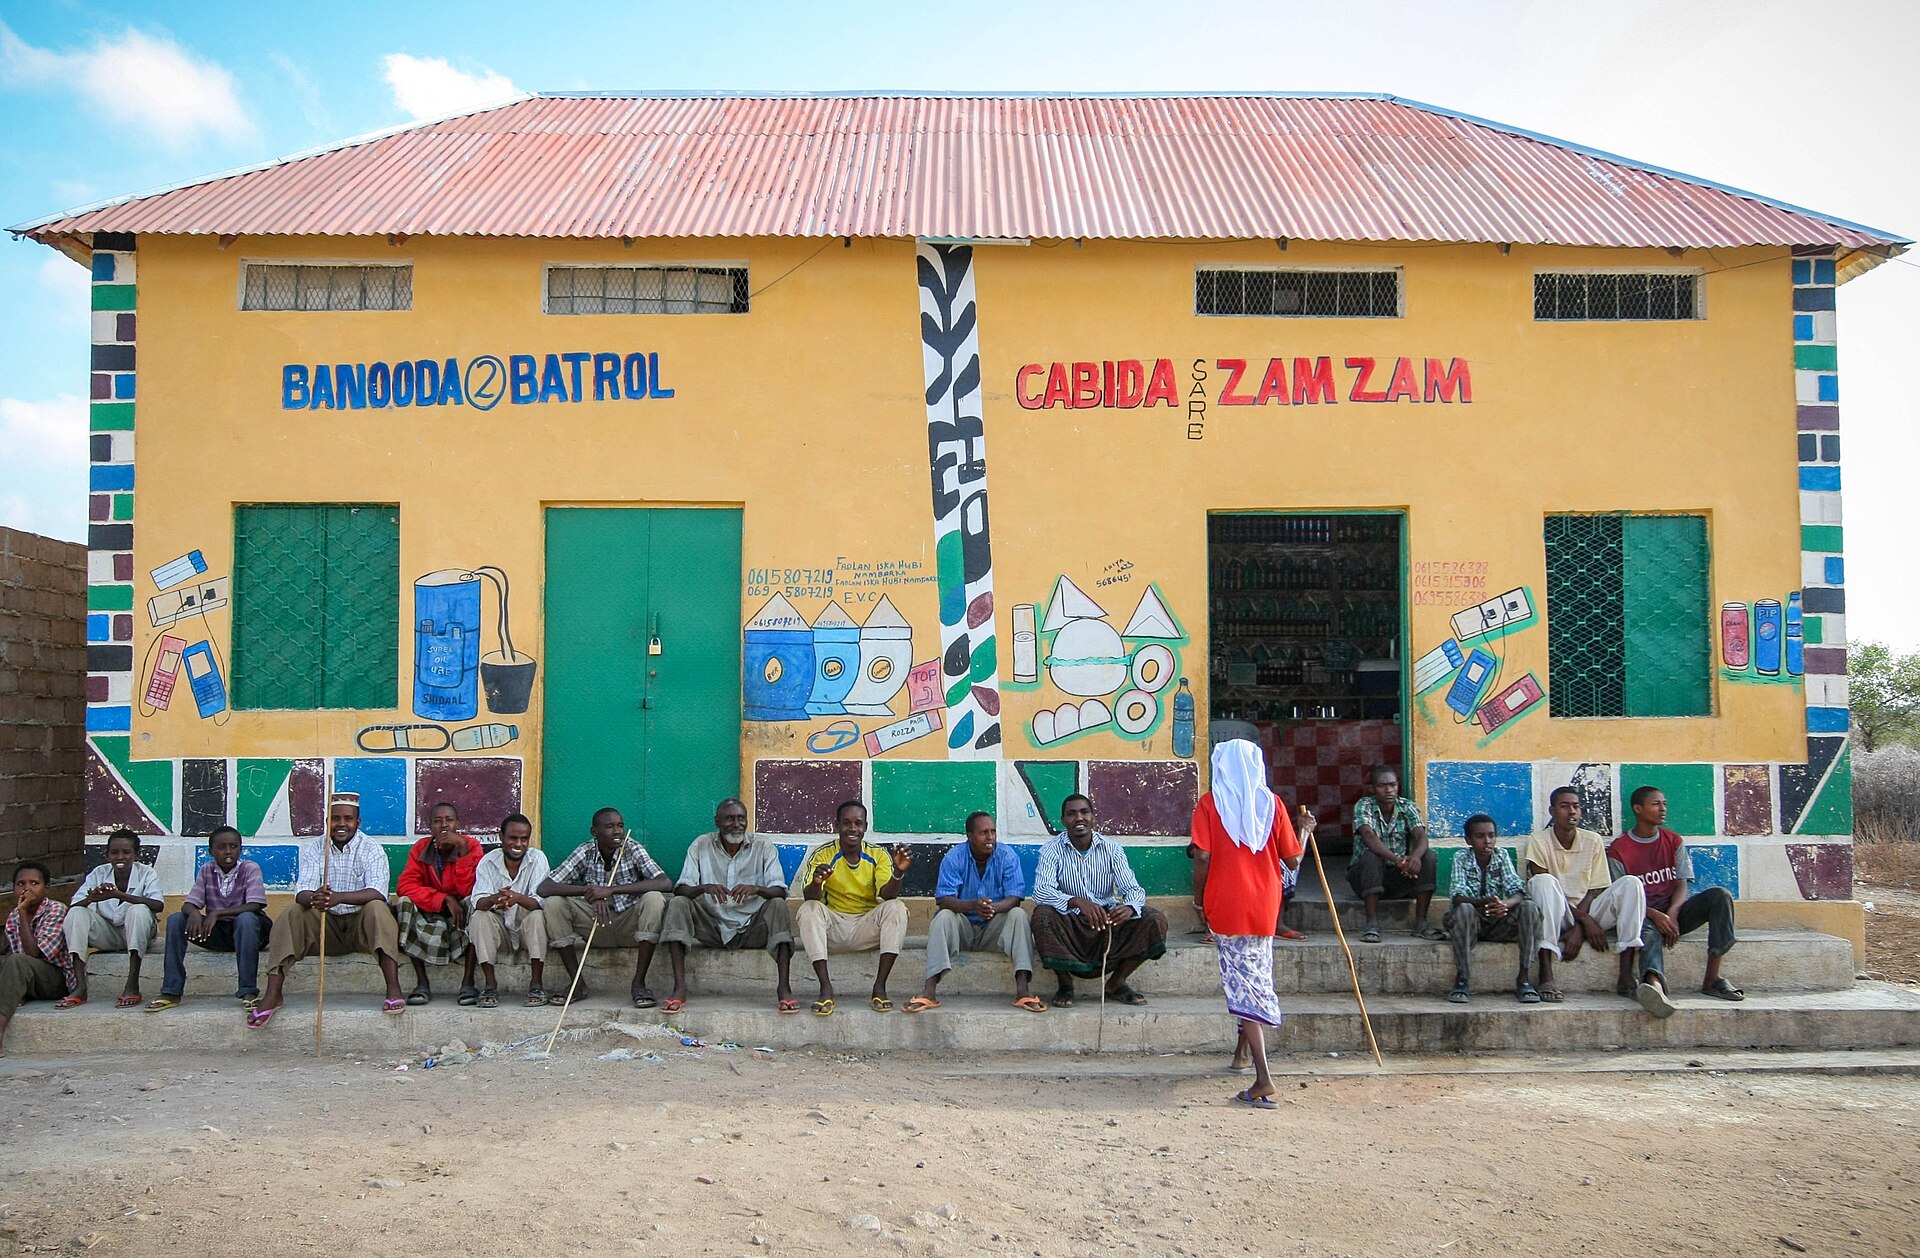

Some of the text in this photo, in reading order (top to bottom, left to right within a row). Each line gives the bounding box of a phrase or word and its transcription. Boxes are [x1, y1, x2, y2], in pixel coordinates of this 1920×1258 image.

[282, 358, 464, 410] BANOODA
[510, 352, 675, 404] BATROL
[1016, 356, 1472, 409] CABIDA ZAM ZAM
[1188, 359, 1208, 440] SARE
[748, 568, 834, 586] 0615807219
[785, 586, 834, 599] 5807219
[434, 656, 448, 664] OIL
[912, 669, 937, 684] TOP
